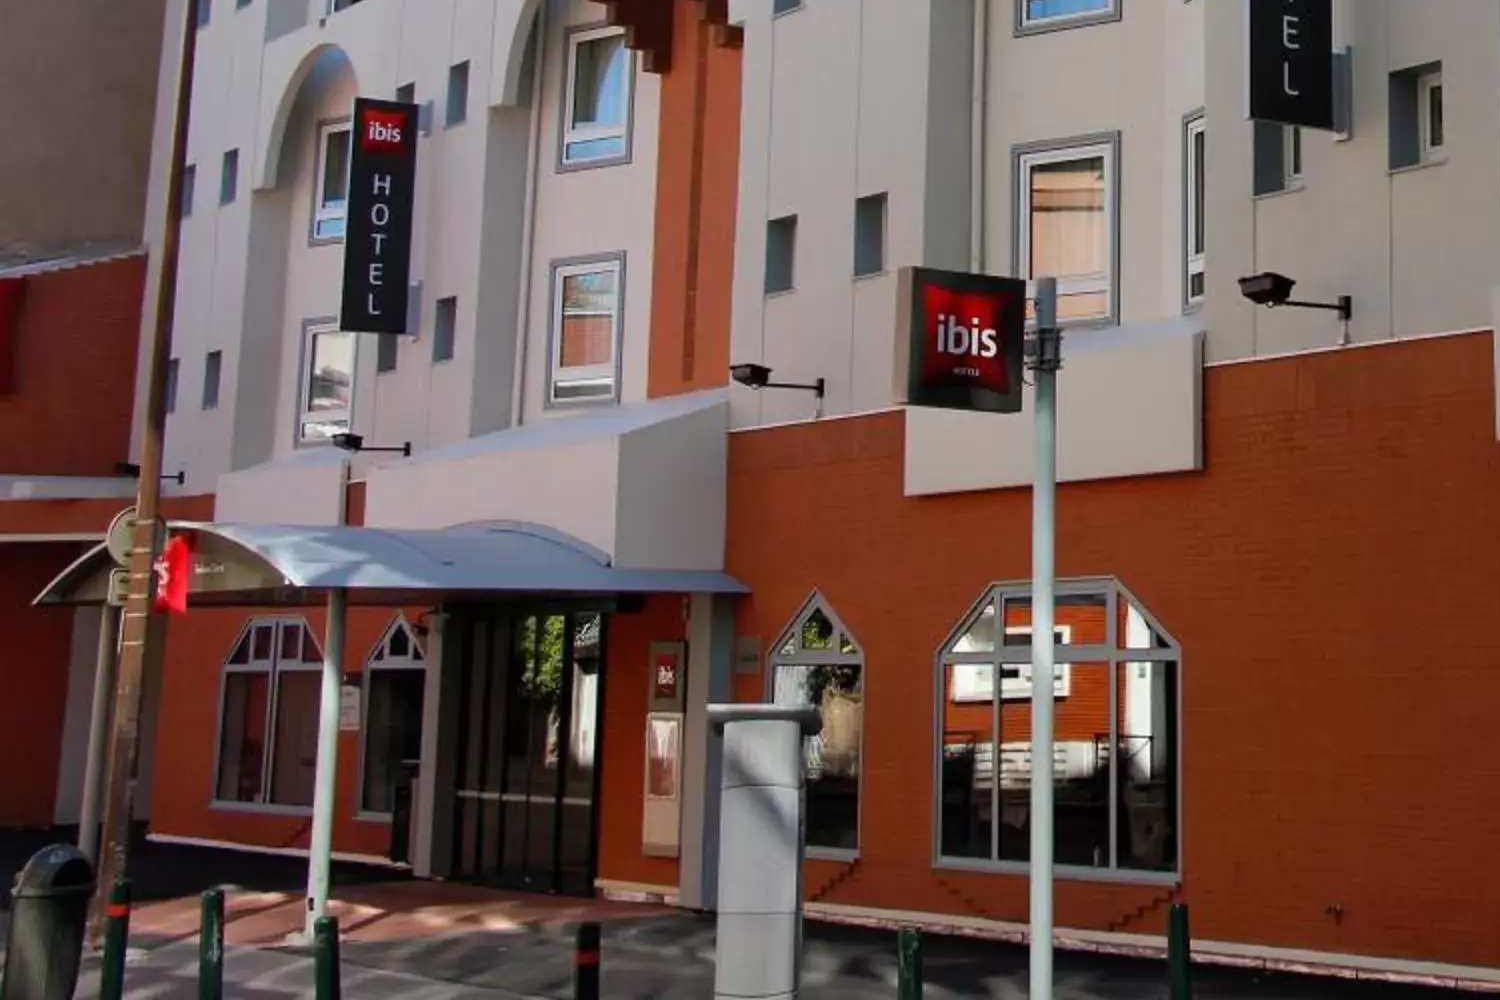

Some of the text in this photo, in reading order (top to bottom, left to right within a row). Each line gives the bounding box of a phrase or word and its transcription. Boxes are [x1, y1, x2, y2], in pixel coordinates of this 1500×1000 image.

[368, 121, 401, 143] ibis
[368, 174, 391, 315] HOTEL
[936, 313, 998, 358] ibis
